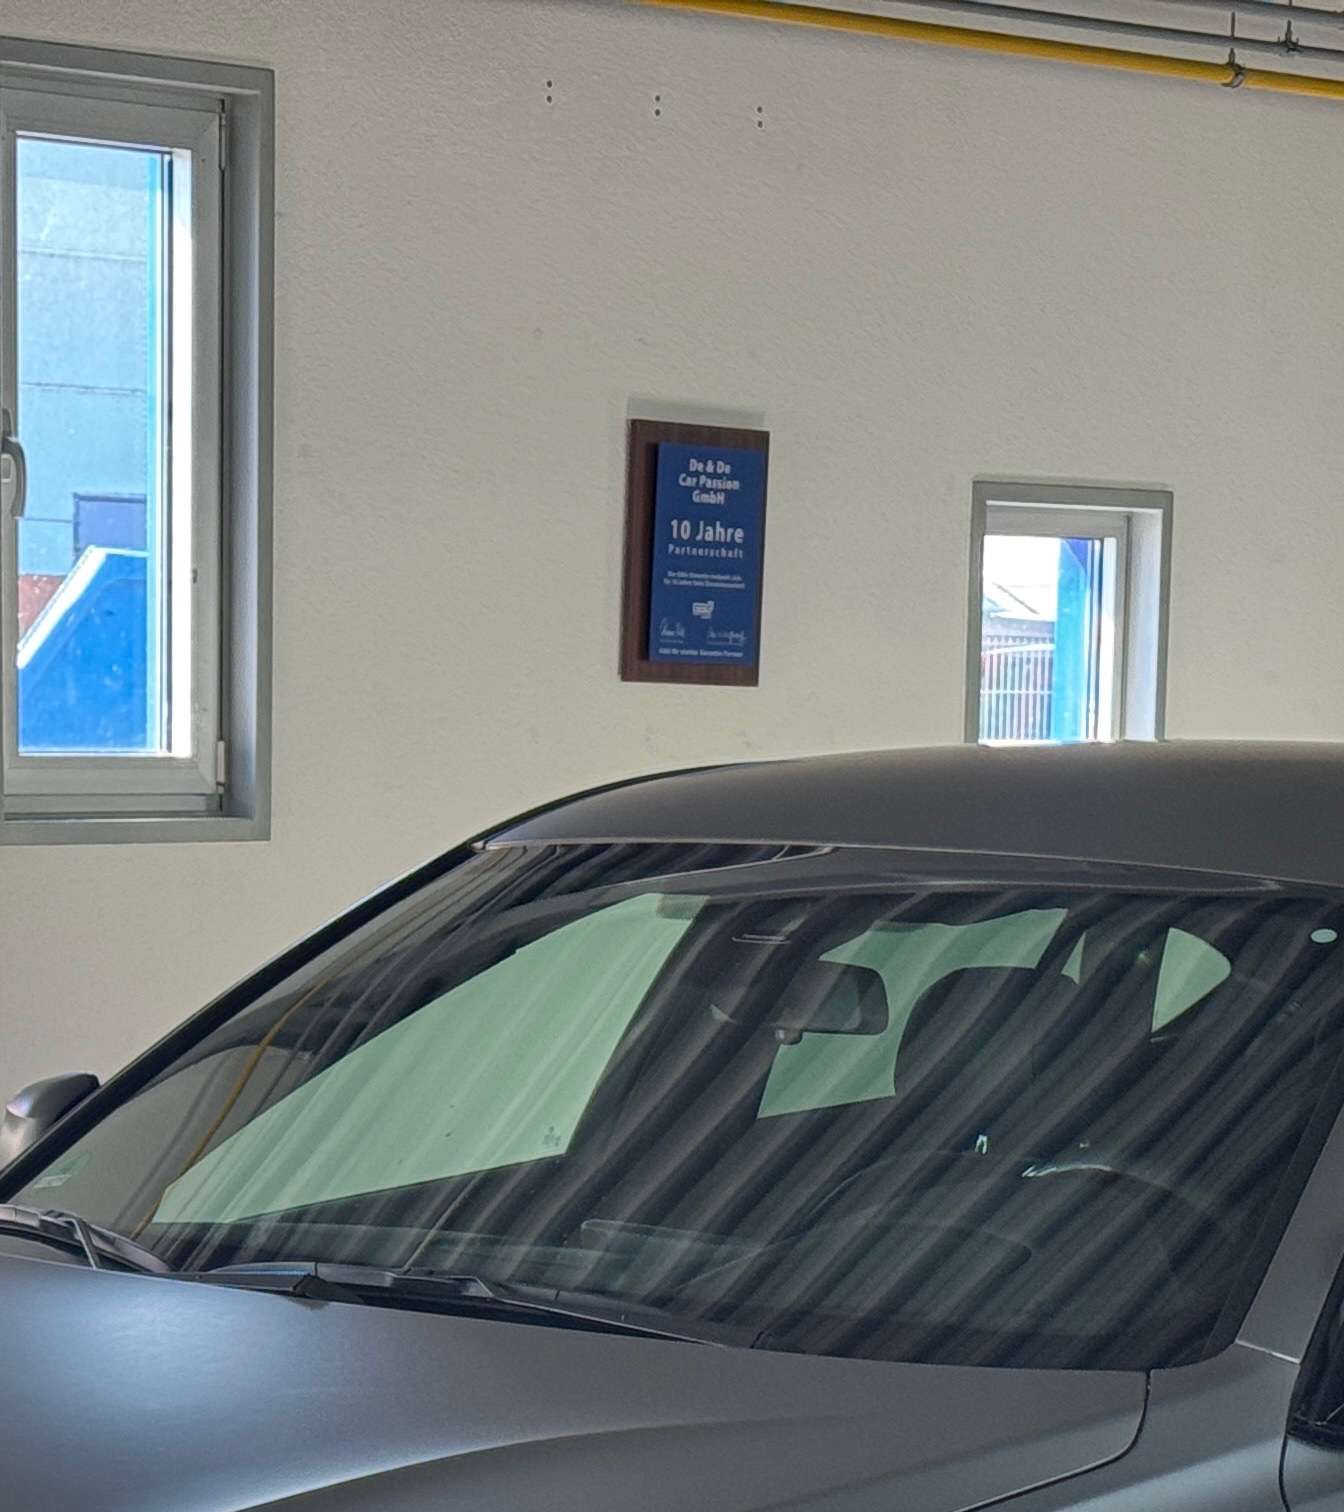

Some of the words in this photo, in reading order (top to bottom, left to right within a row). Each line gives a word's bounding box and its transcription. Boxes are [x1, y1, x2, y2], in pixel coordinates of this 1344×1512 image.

[689, 459, 704, 472] De
[705, 460, 714, 473] &
[716, 461, 731, 474] De
[678, 473, 697, 487] Car
[699, 475, 740, 490] Passion
[692, 490, 725, 504] GmbH
[671, 519, 691, 539] 10
[695, 521, 744, 543] Jahre
[668, 543, 743, 558] Partnerschaft
